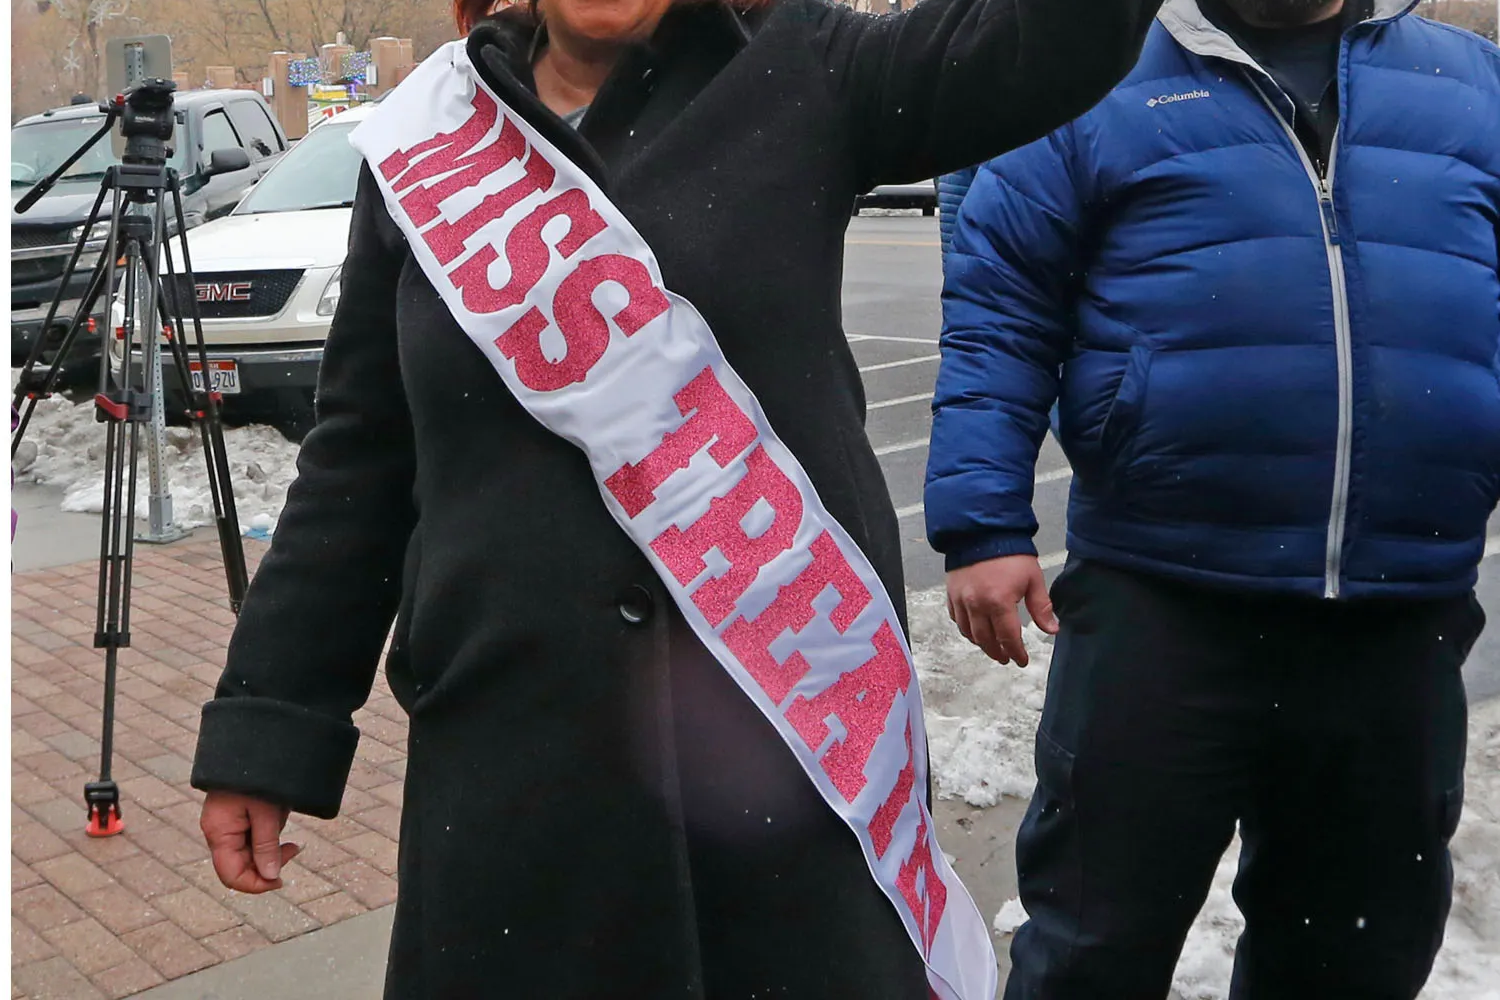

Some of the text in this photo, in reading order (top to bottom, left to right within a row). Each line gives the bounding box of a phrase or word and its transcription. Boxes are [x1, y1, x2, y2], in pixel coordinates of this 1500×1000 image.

[1158, 89, 1210, 104] Columbia
[380, 87, 669, 391] MISS
[194, 283, 252, 301] GMC
